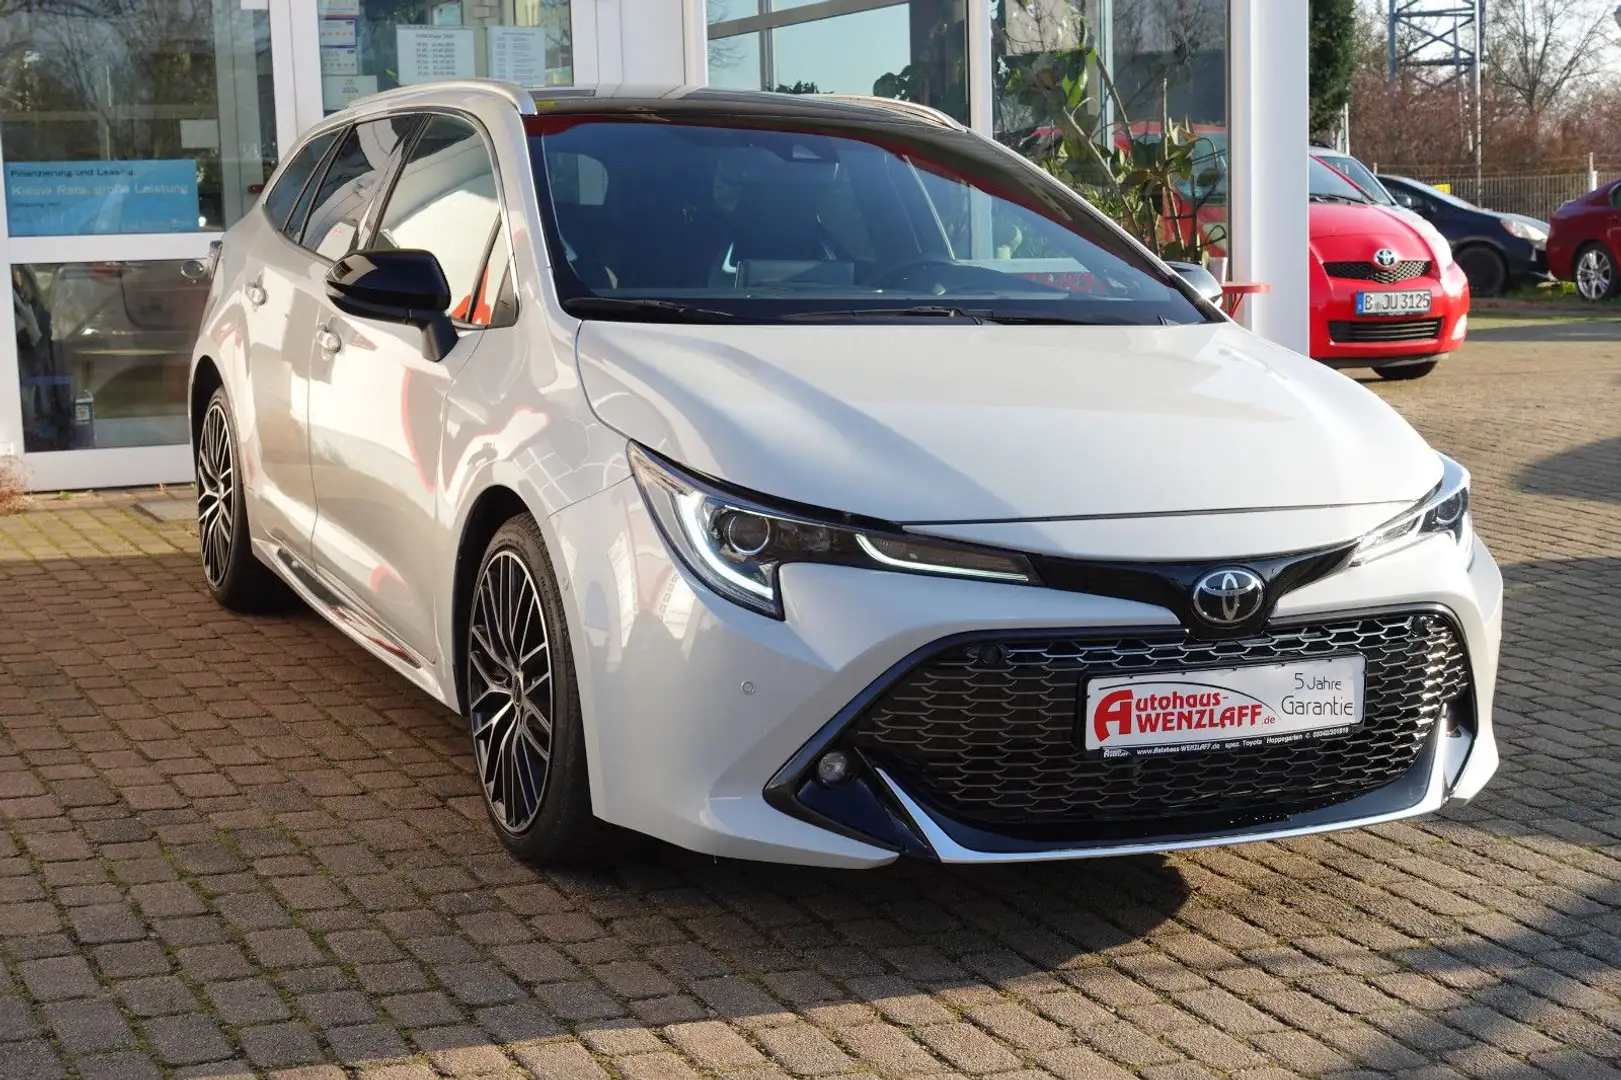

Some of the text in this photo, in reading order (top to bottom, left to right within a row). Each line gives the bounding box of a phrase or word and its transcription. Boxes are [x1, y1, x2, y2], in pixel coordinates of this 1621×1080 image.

[1364, 294, 1373, 310] B
[1294, 672, 1342, 691] 5 Jahre
[1281, 695, 1354, 716] Garantie
[1242, 738, 1263, 747] Toyota
[1266, 733, 1303, 744] Hoppegarten
